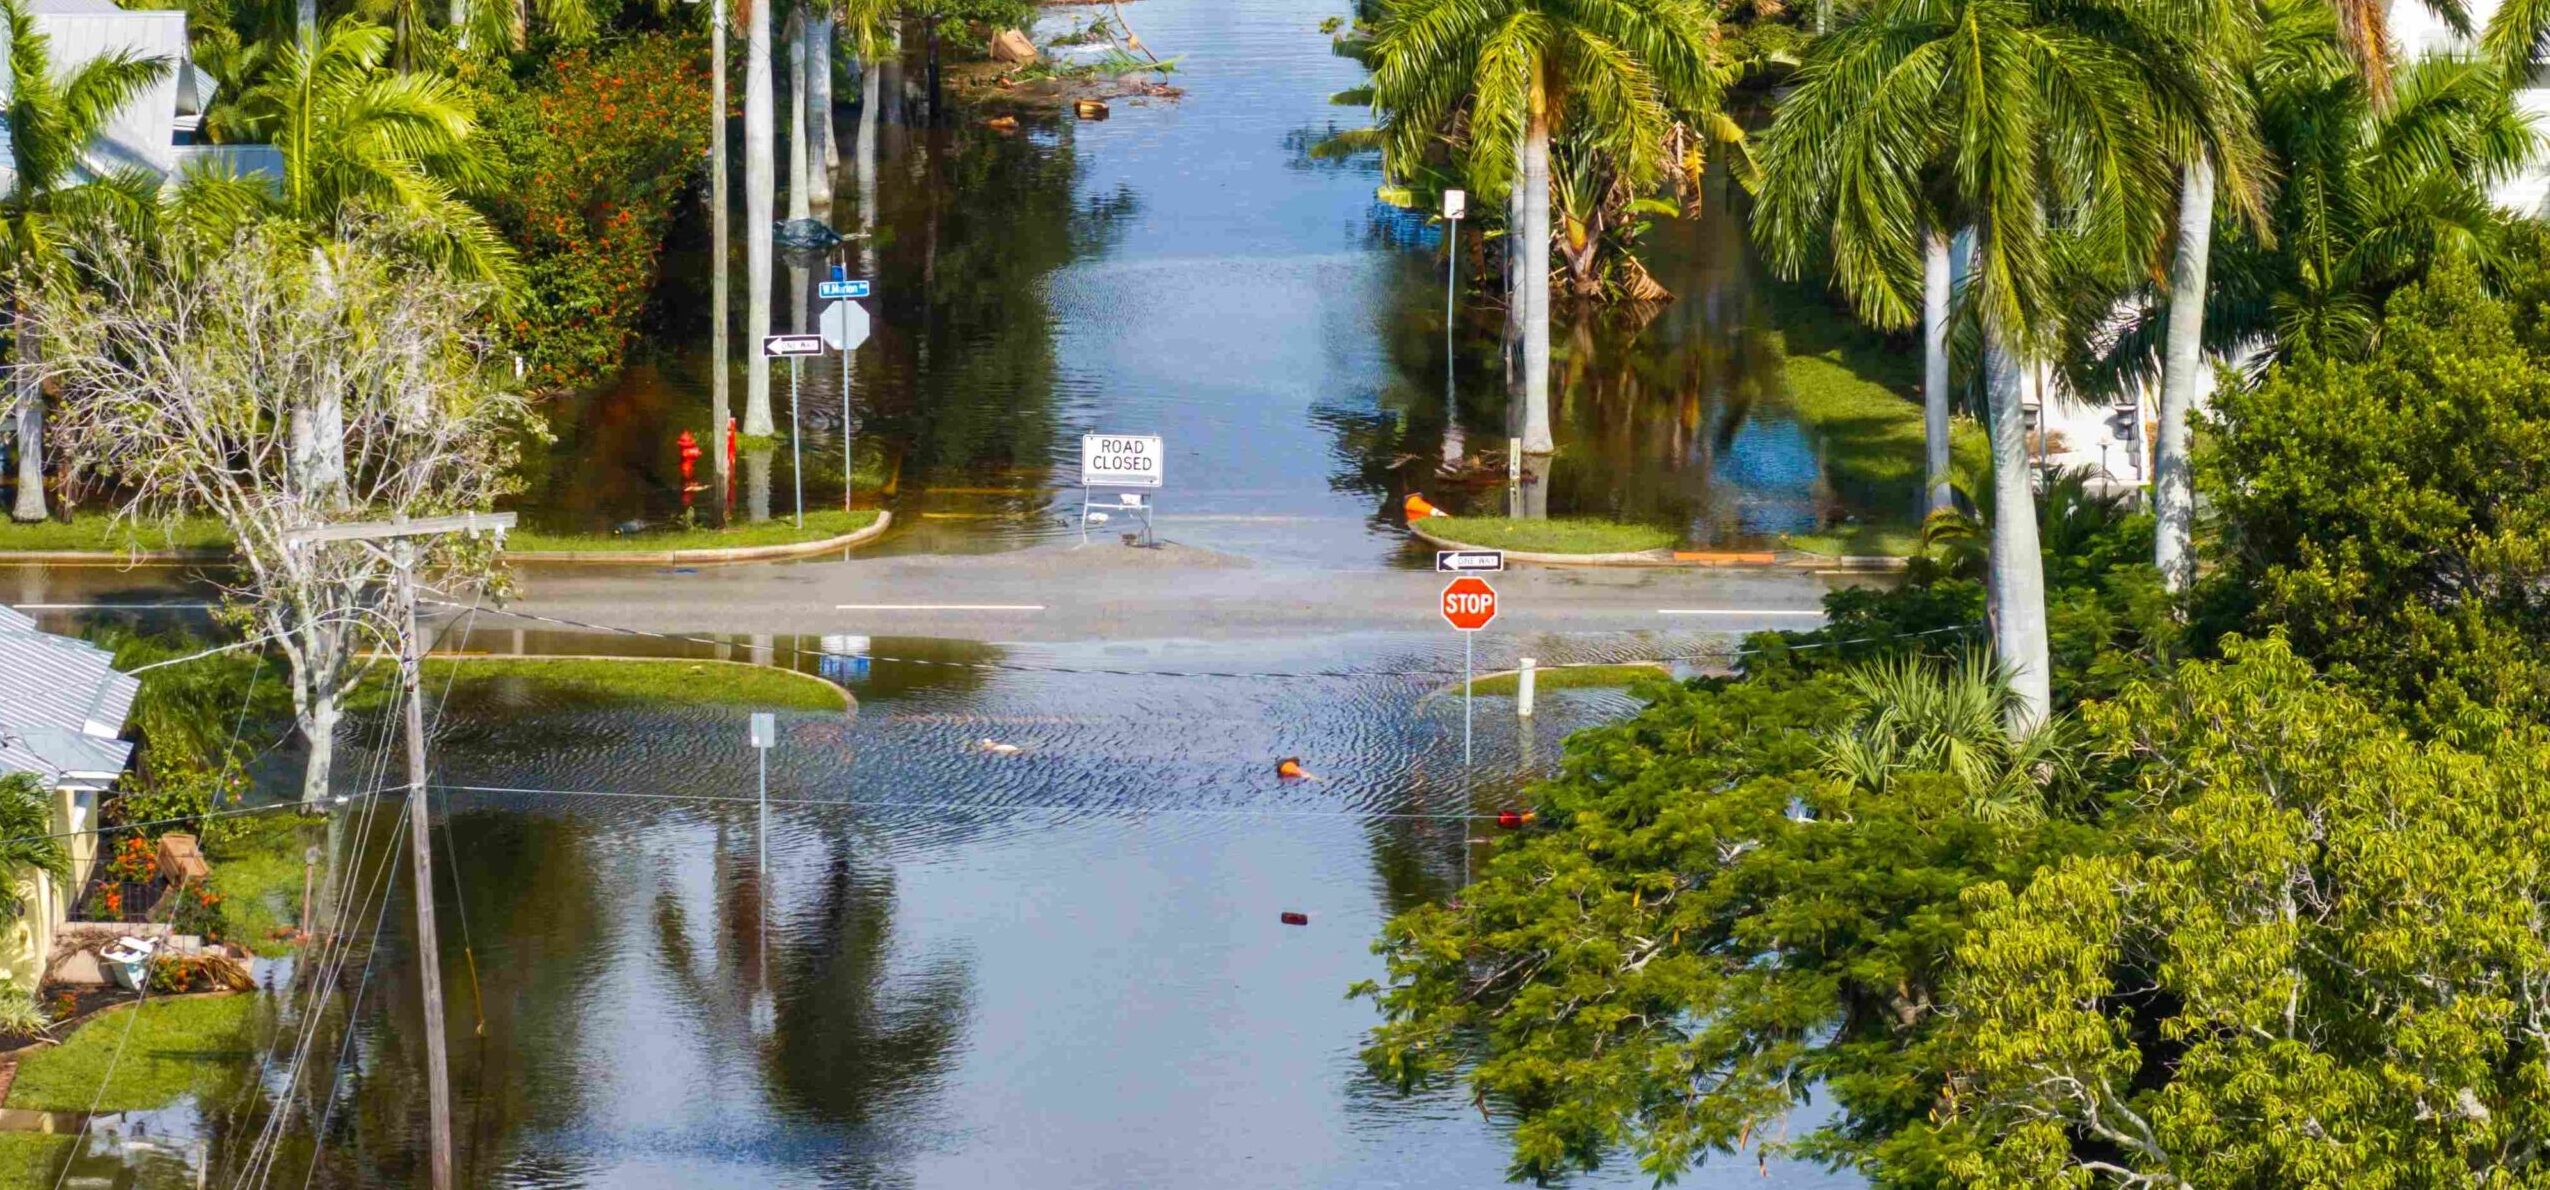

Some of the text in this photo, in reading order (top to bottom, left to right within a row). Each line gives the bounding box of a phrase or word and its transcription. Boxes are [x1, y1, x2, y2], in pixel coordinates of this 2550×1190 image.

[1101, 439, 1145, 454] ROAD
[1093, 455, 1153, 471] CLOSED
[1457, 557, 1496, 565] ONE WAY
[1445, 593, 1493, 614] STOP
